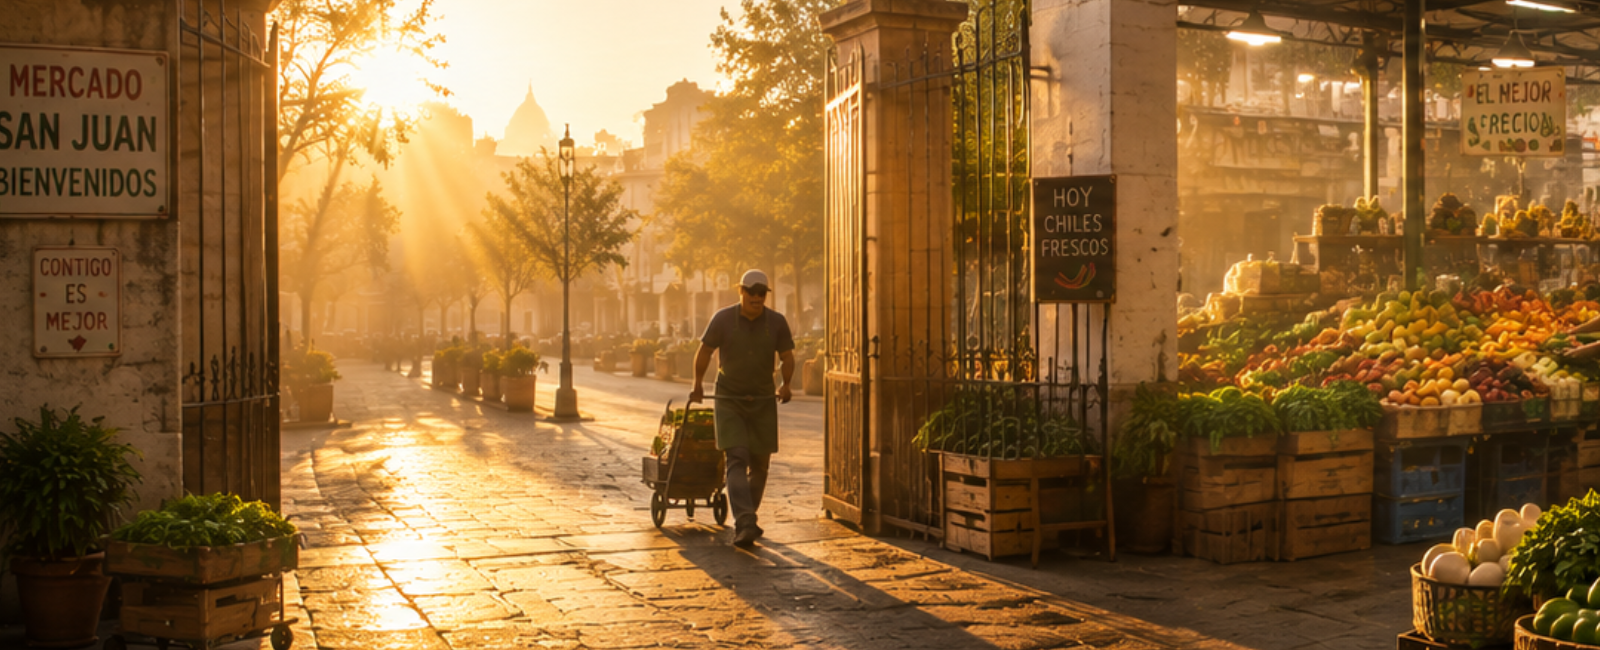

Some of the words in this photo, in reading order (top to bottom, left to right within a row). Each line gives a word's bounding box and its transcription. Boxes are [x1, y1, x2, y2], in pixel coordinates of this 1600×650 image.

[10, 64, 142, 100] MERCADO
[1476, 83, 1495, 105] EL
[0, 111, 59, 150] SAN
[71, 114, 156, 152] JUAN
[0, 167, 157, 197] BIENVENIDOS
[1053, 185, 1093, 208] HOY
[1044, 213, 1103, 233] CHILES
[1041, 238, 1109, 257] FRESCOS
[40, 257, 112, 277] CONTIGO
[65, 283, 87, 304] ES
[46, 311, 108, 331] MEJOR
